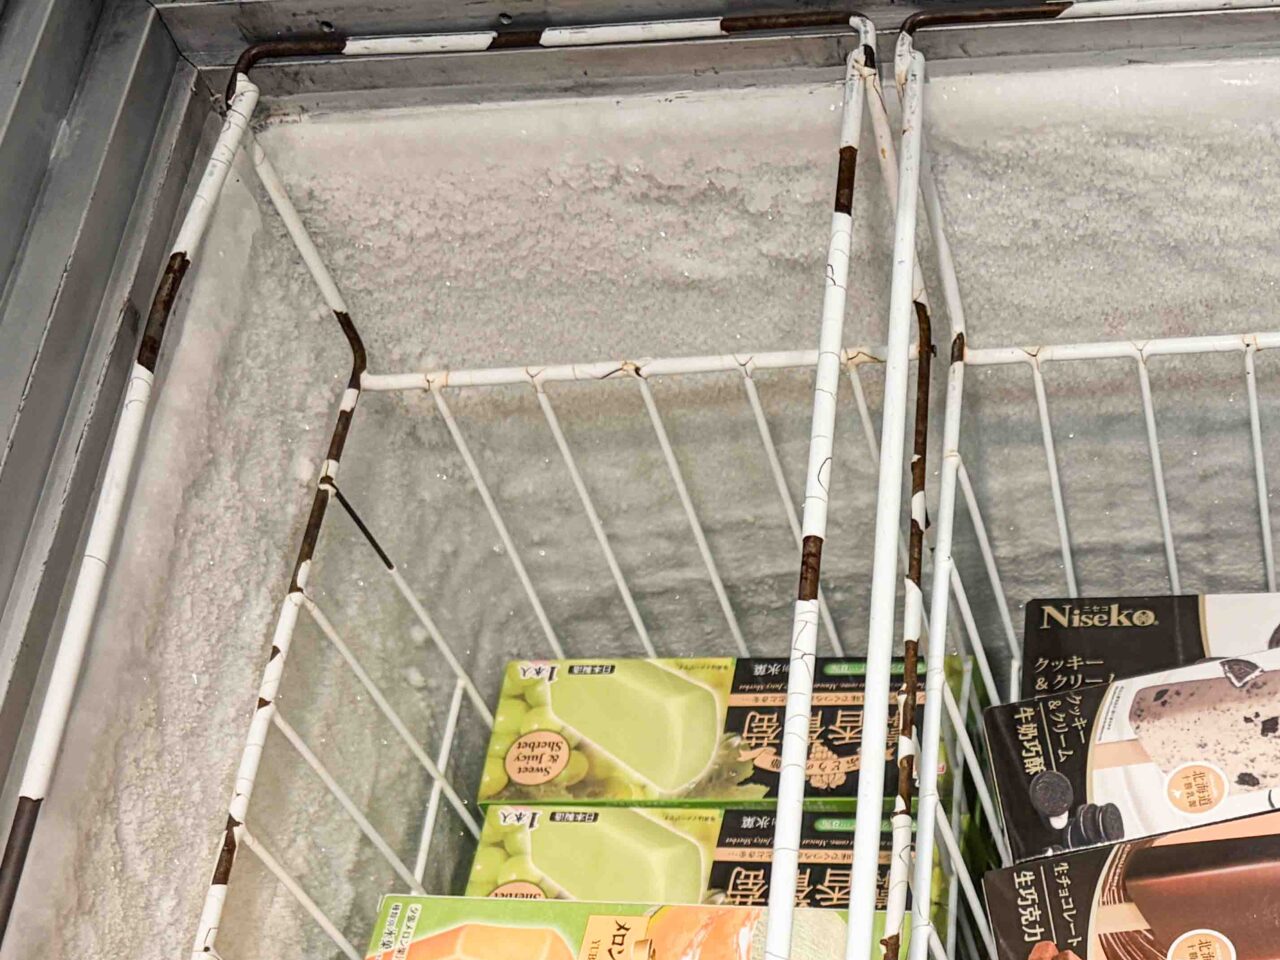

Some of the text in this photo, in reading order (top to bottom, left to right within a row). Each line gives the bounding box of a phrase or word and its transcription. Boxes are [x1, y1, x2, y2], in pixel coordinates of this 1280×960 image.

[1040, 603, 1157, 629] Niseko
[1034, 655, 1104, 672] クッキー
[1048, 699, 1074, 763] &クリーム
[1066, 691, 1088, 744] クッキー
[513, 752, 560, 764] & Juicy
[515, 740, 564, 751] Sherbet
[1014, 706, 1047, 776] 牛奶巧酥
[516, 765, 552, 775] Sweet
[1013, 871, 1045, 942] 生巧克力
[1053, 862, 1083, 947] 生チョコレート
